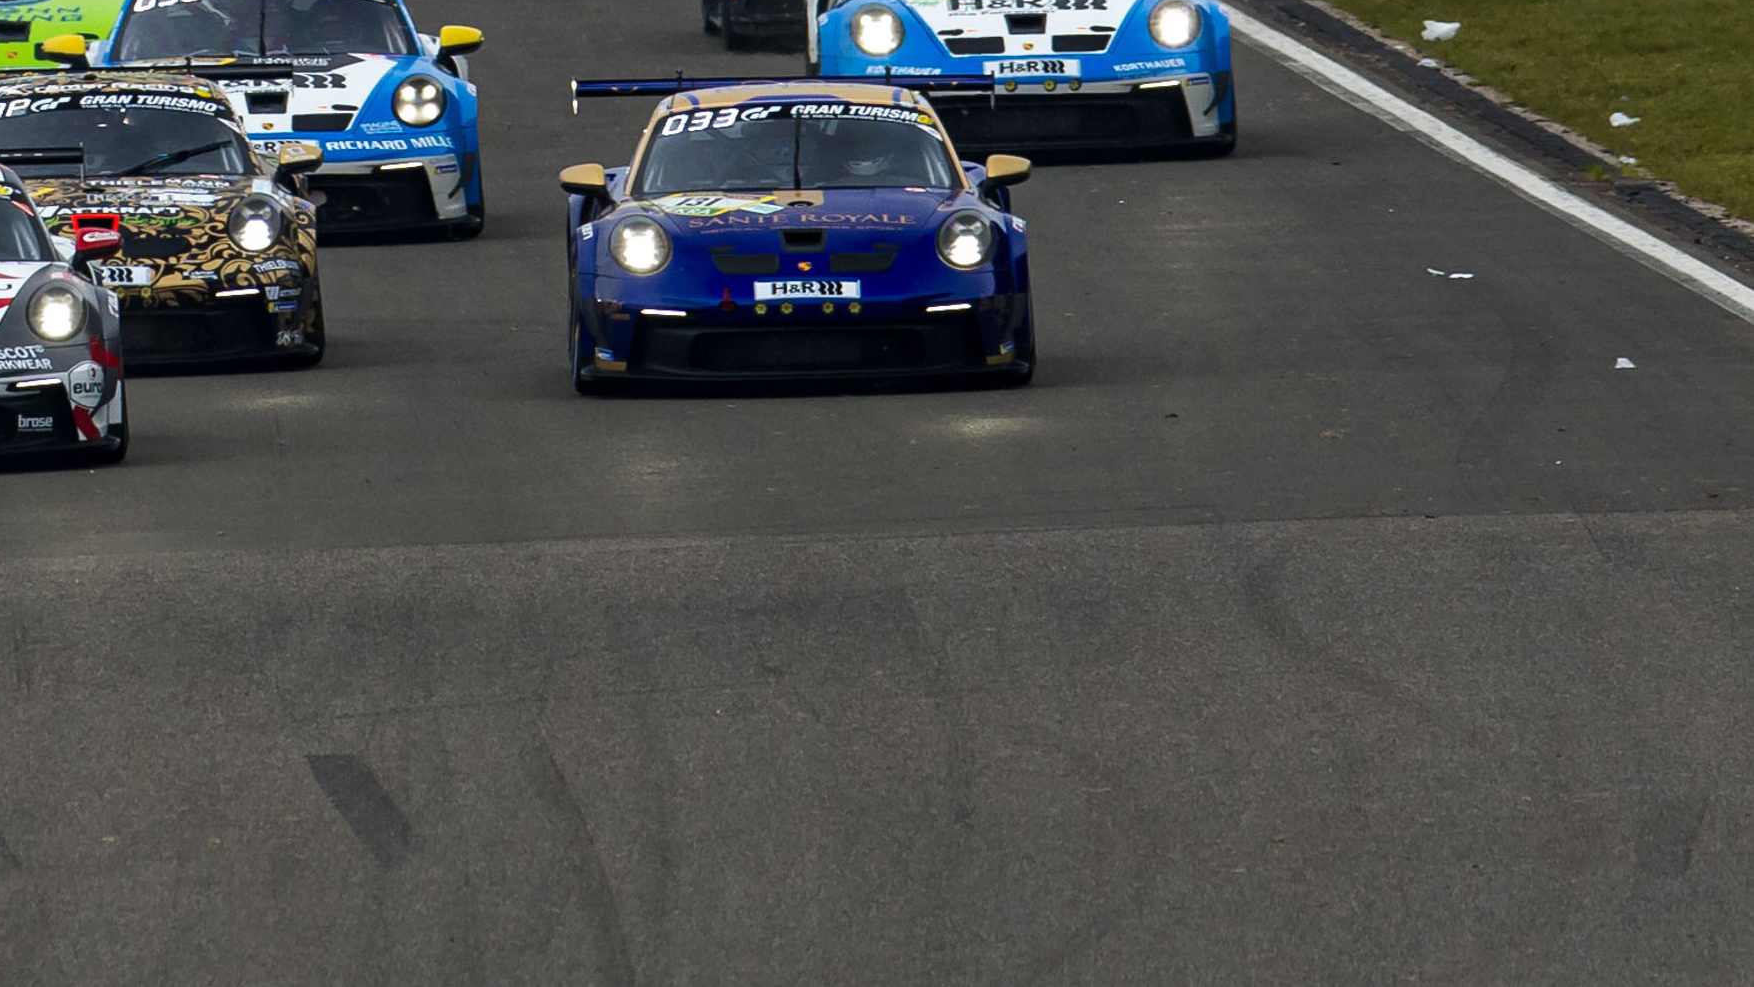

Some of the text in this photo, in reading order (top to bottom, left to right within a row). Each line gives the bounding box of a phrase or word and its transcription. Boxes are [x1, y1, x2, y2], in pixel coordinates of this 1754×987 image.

[865, 65, 943, 76] KOTHAUER
[78, 95, 133, 107] GRAN
[136, 95, 219, 113] TURISMO
[790, 104, 846, 116] GRAN
[847, 105, 934, 124] TURISM
[661, 107, 740, 137] 033
[325, 137, 408, 152] RICHARD
[798, 210, 917, 226] ROYALE
[73, 379, 104, 394] euro
[17, 414, 53, 428] brose
